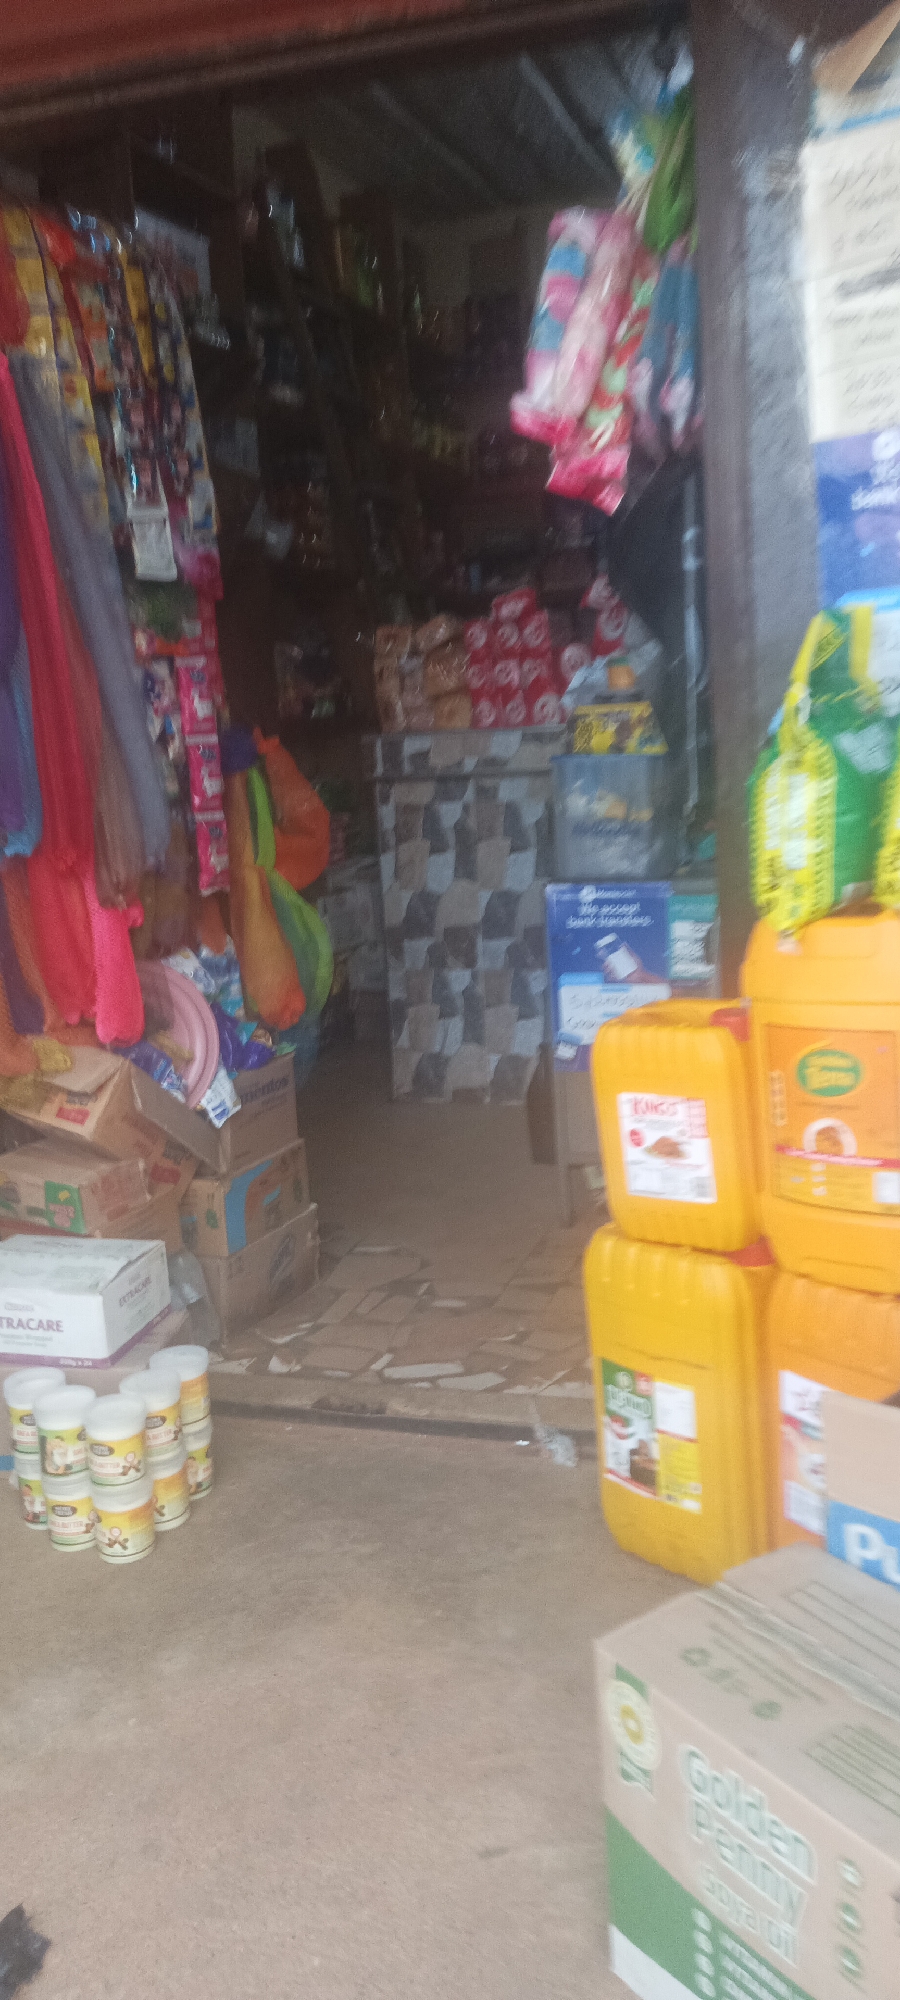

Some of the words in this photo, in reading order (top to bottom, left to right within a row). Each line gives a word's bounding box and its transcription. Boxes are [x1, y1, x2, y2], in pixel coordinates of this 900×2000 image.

[0, 1316, 64, 1333] TRACARE
[679, 1744, 817, 1885] Golden
[687, 1795, 807, 1932] Penny
